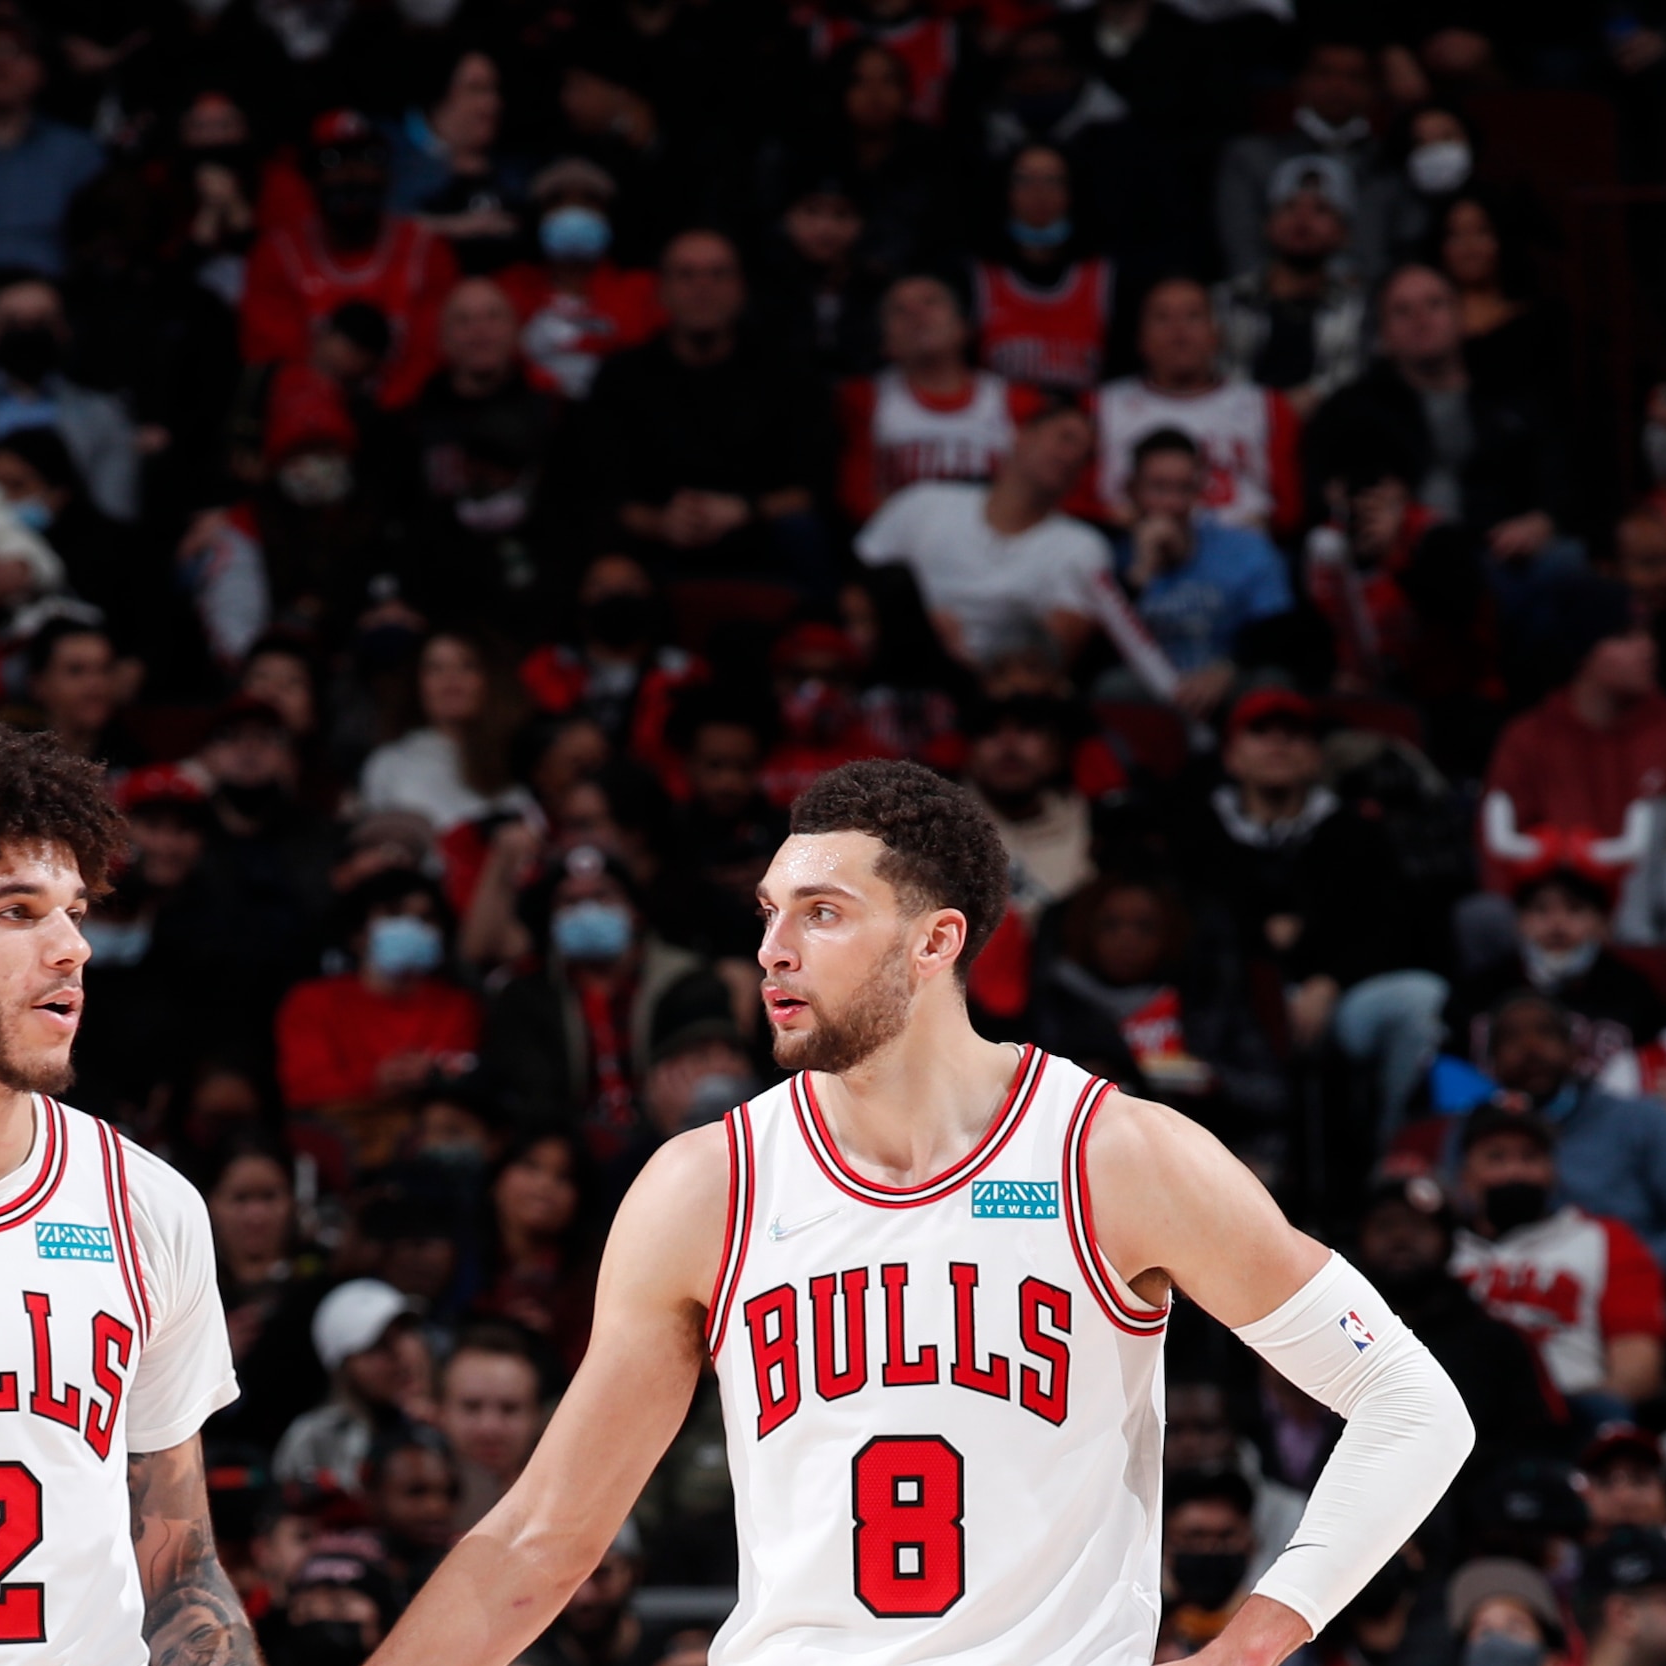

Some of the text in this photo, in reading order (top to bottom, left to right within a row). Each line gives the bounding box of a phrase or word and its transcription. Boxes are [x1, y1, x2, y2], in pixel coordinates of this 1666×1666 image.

[974, 1183, 1056, 1201] ZENNI
[974, 1204, 1056, 1215] EYEWEAR
[37, 1225, 110, 1246] ZENNI
[39, 1246, 112, 1260] EYEWEAR
[744, 1262, 1072, 1441] BULLS
[852, 1435, 964, 1618] 8
